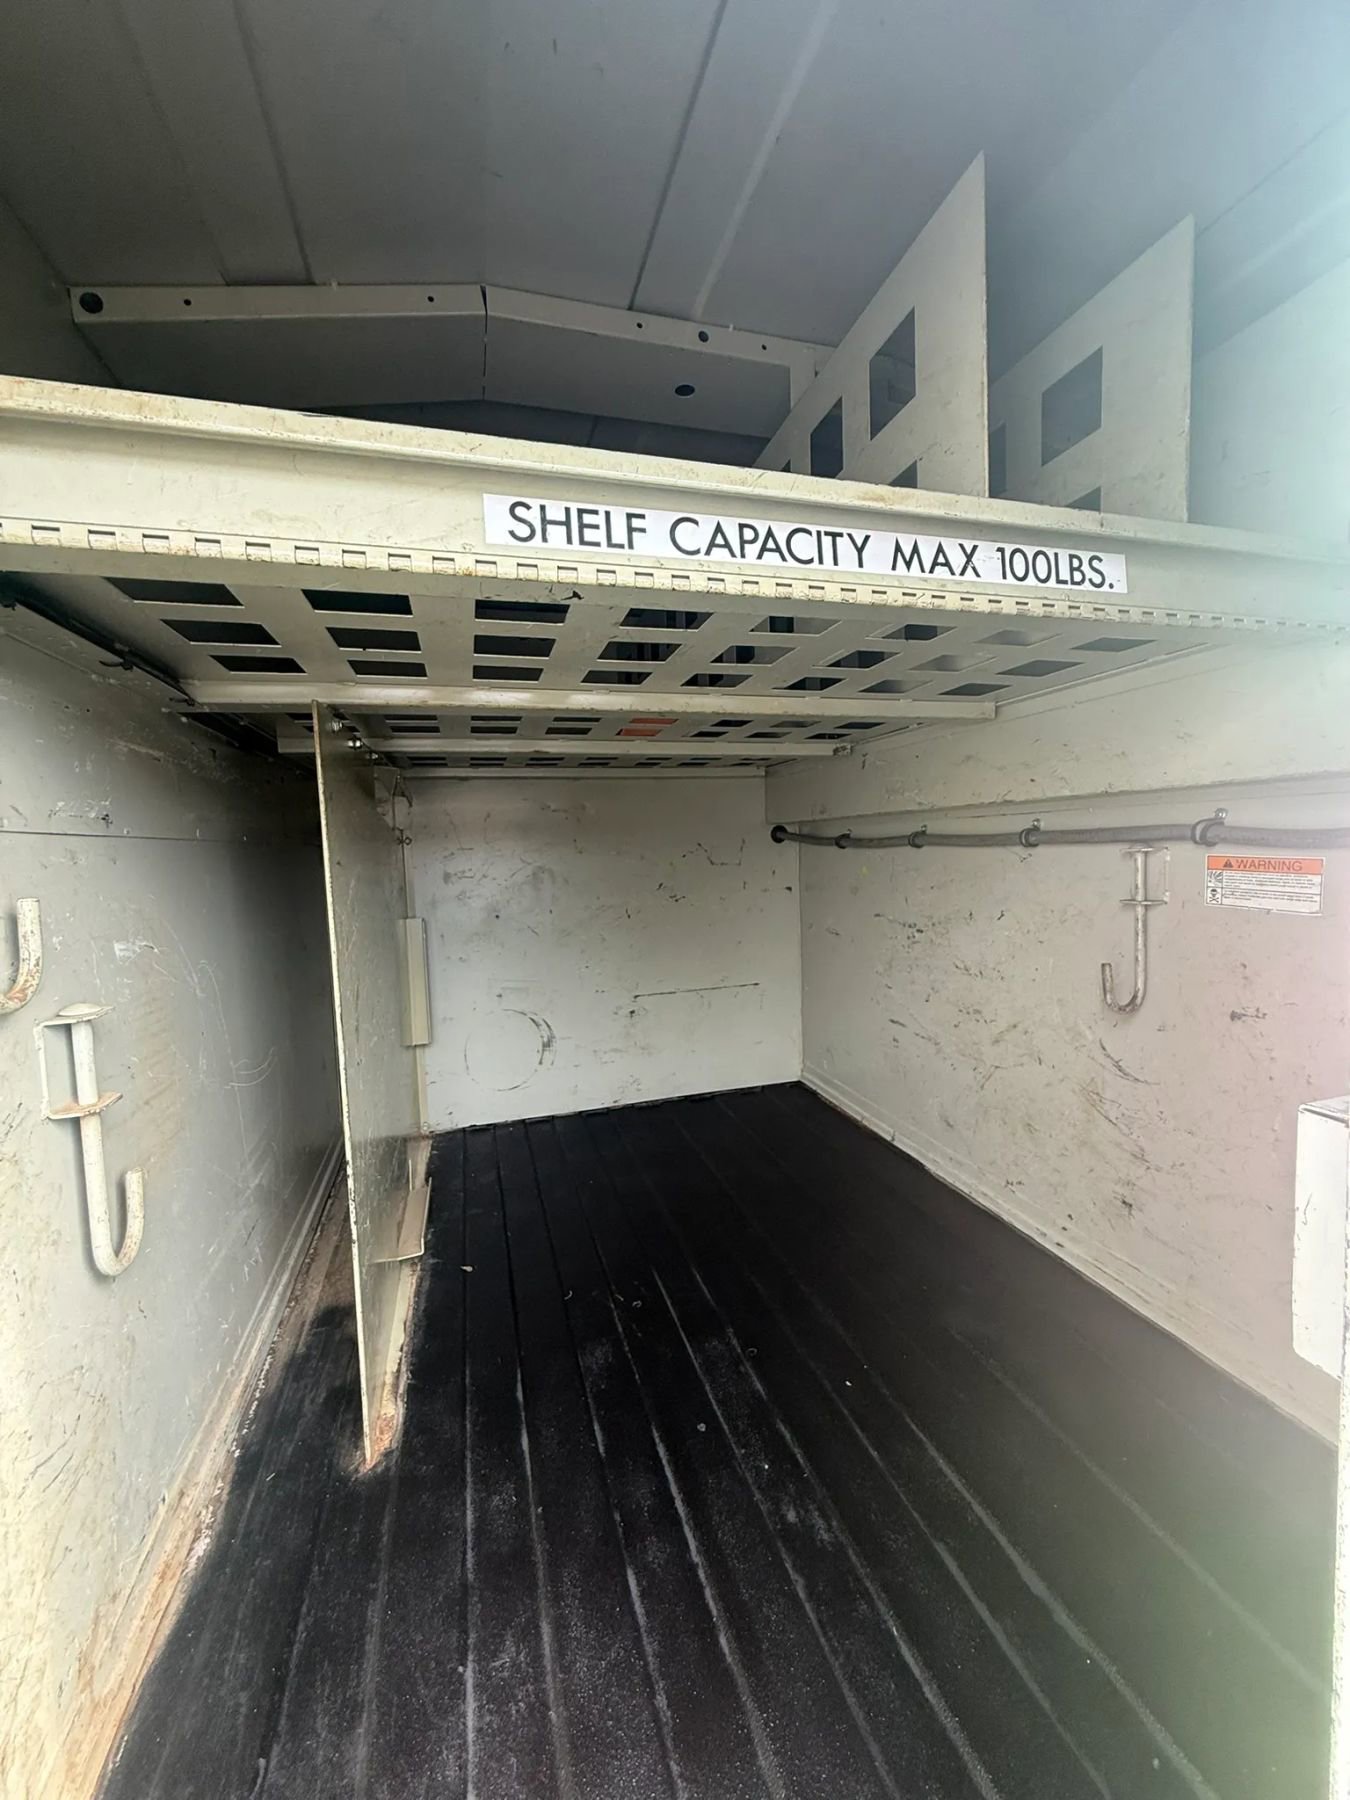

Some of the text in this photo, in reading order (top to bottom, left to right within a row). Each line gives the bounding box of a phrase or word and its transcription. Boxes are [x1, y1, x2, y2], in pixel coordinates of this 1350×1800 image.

[508, 501, 1114, 590] SHELF CAPACITY MAX 100LBS.
[1236, 859, 1303, 872] WARNING
